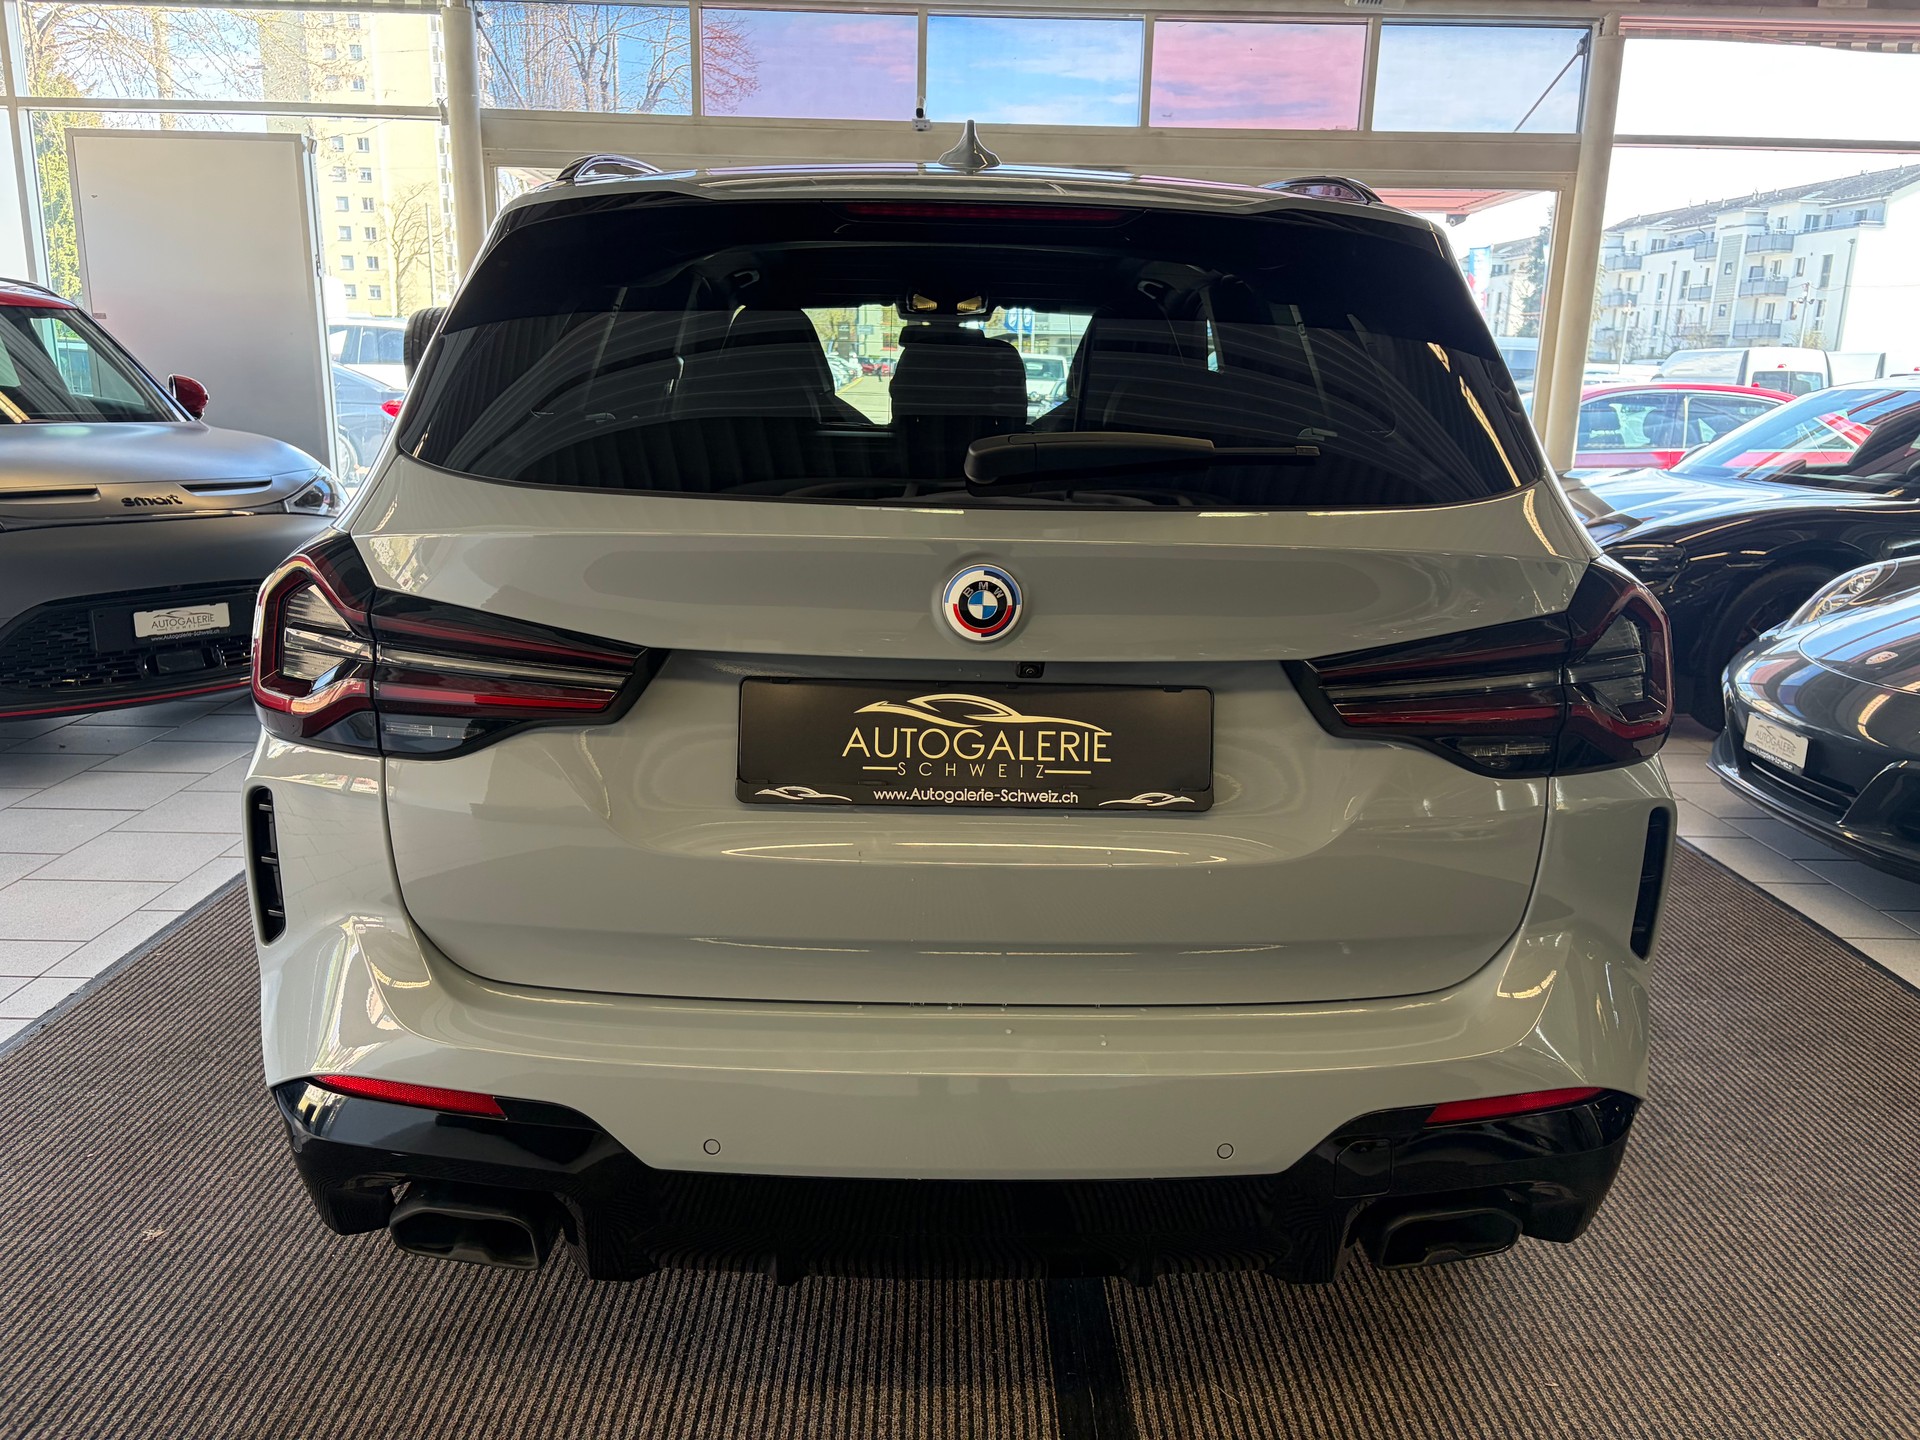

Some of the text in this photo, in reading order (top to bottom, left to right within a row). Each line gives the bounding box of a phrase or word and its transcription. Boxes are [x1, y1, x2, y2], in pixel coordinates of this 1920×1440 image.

[121, 494, 183, 507] smart
[962, 581, 1004, 599] BMW
[151, 614, 215, 629] AUTOGALERIE
[842, 726, 1112, 763] AUTOGALERIE
[897, 762, 1045, 780] SCHWEIZ
[873, 787, 1079, 805] www.Autogalerie-Schweiz.ch
